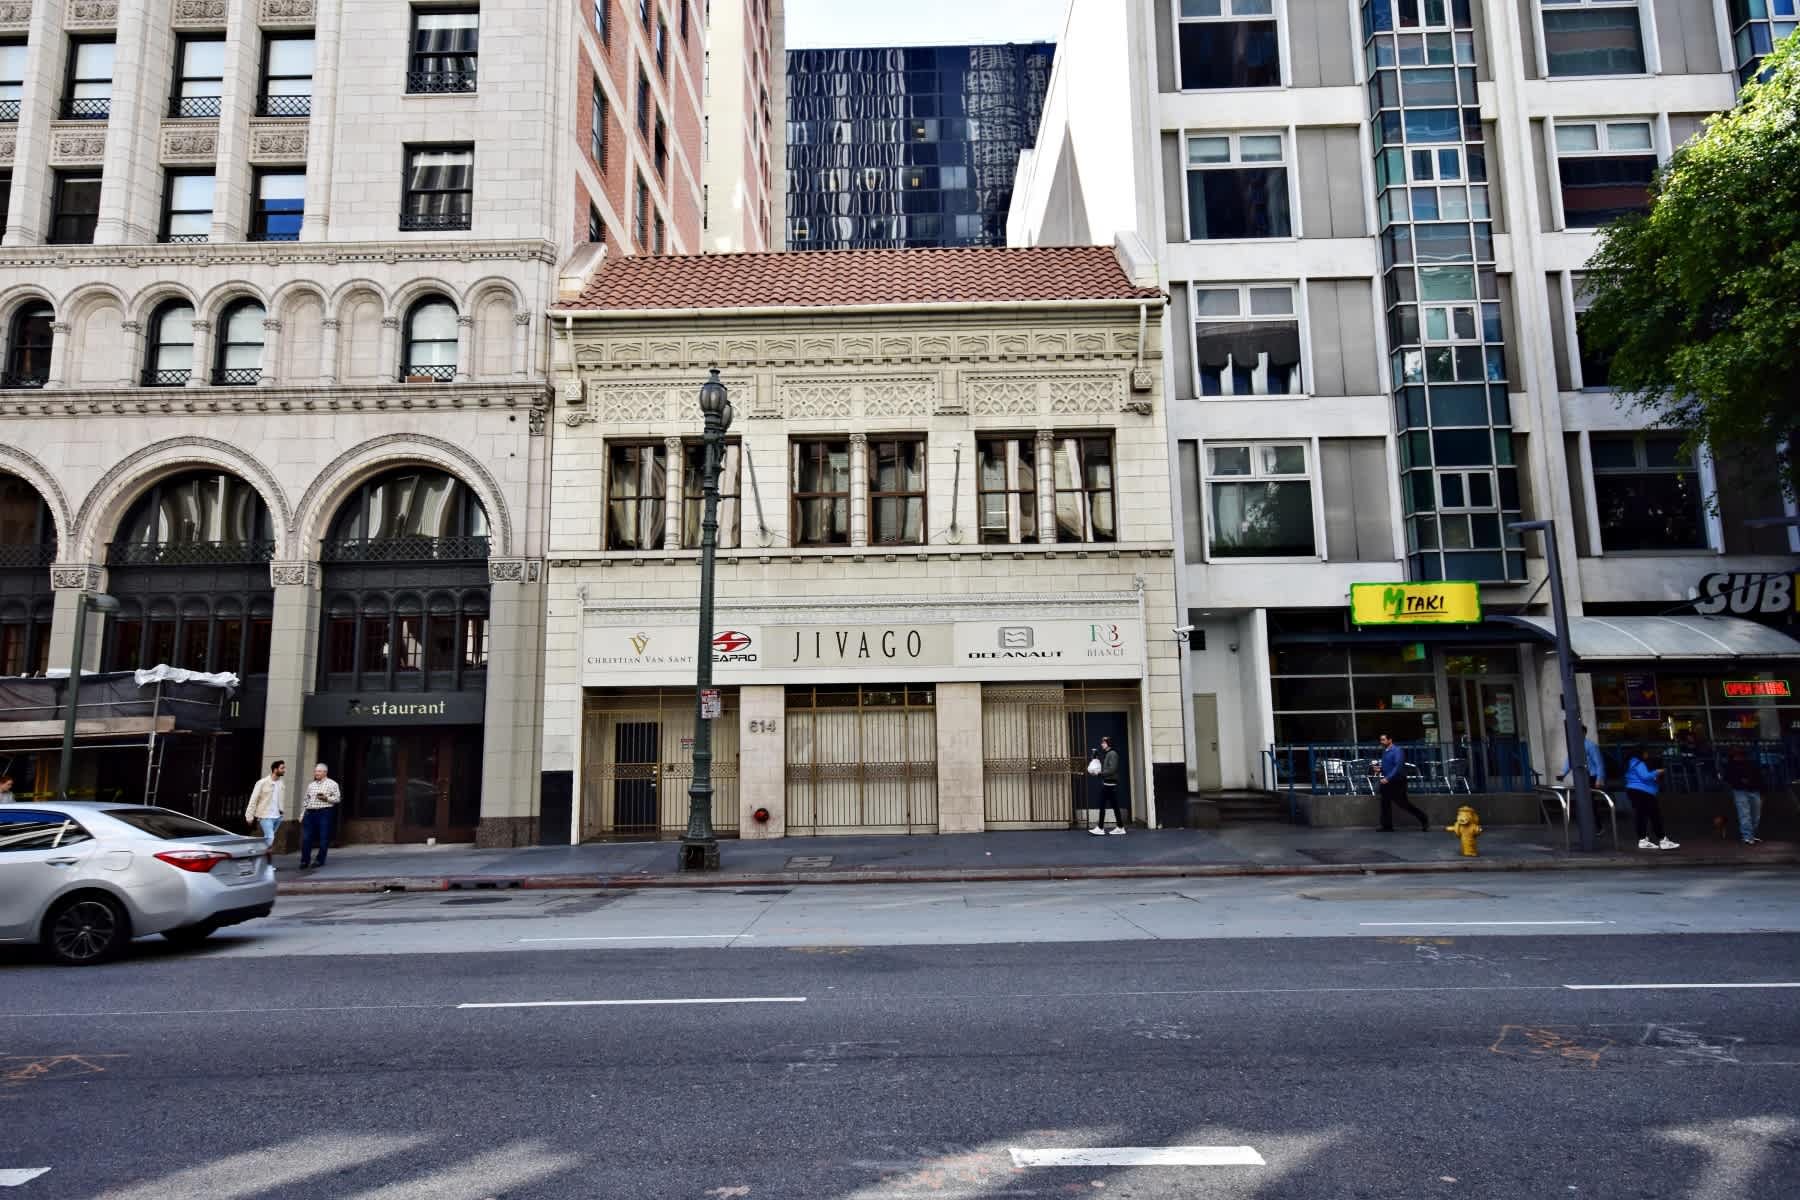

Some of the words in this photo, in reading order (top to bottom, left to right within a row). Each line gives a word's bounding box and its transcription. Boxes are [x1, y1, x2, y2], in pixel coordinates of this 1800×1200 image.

[1693, 574, 1800, 614] SUB
[1406, 595, 1445, 611] TAKI
[792, 630, 922, 662] JIVAGO
[587, 656, 640, 664] CHRISTIAN
[645, 655, 664, 663] VAN
[712, 654, 757, 662] EAPRO
[968, 651, 1062, 659] OCEANAUT
[353, 700, 446, 715] staurant
